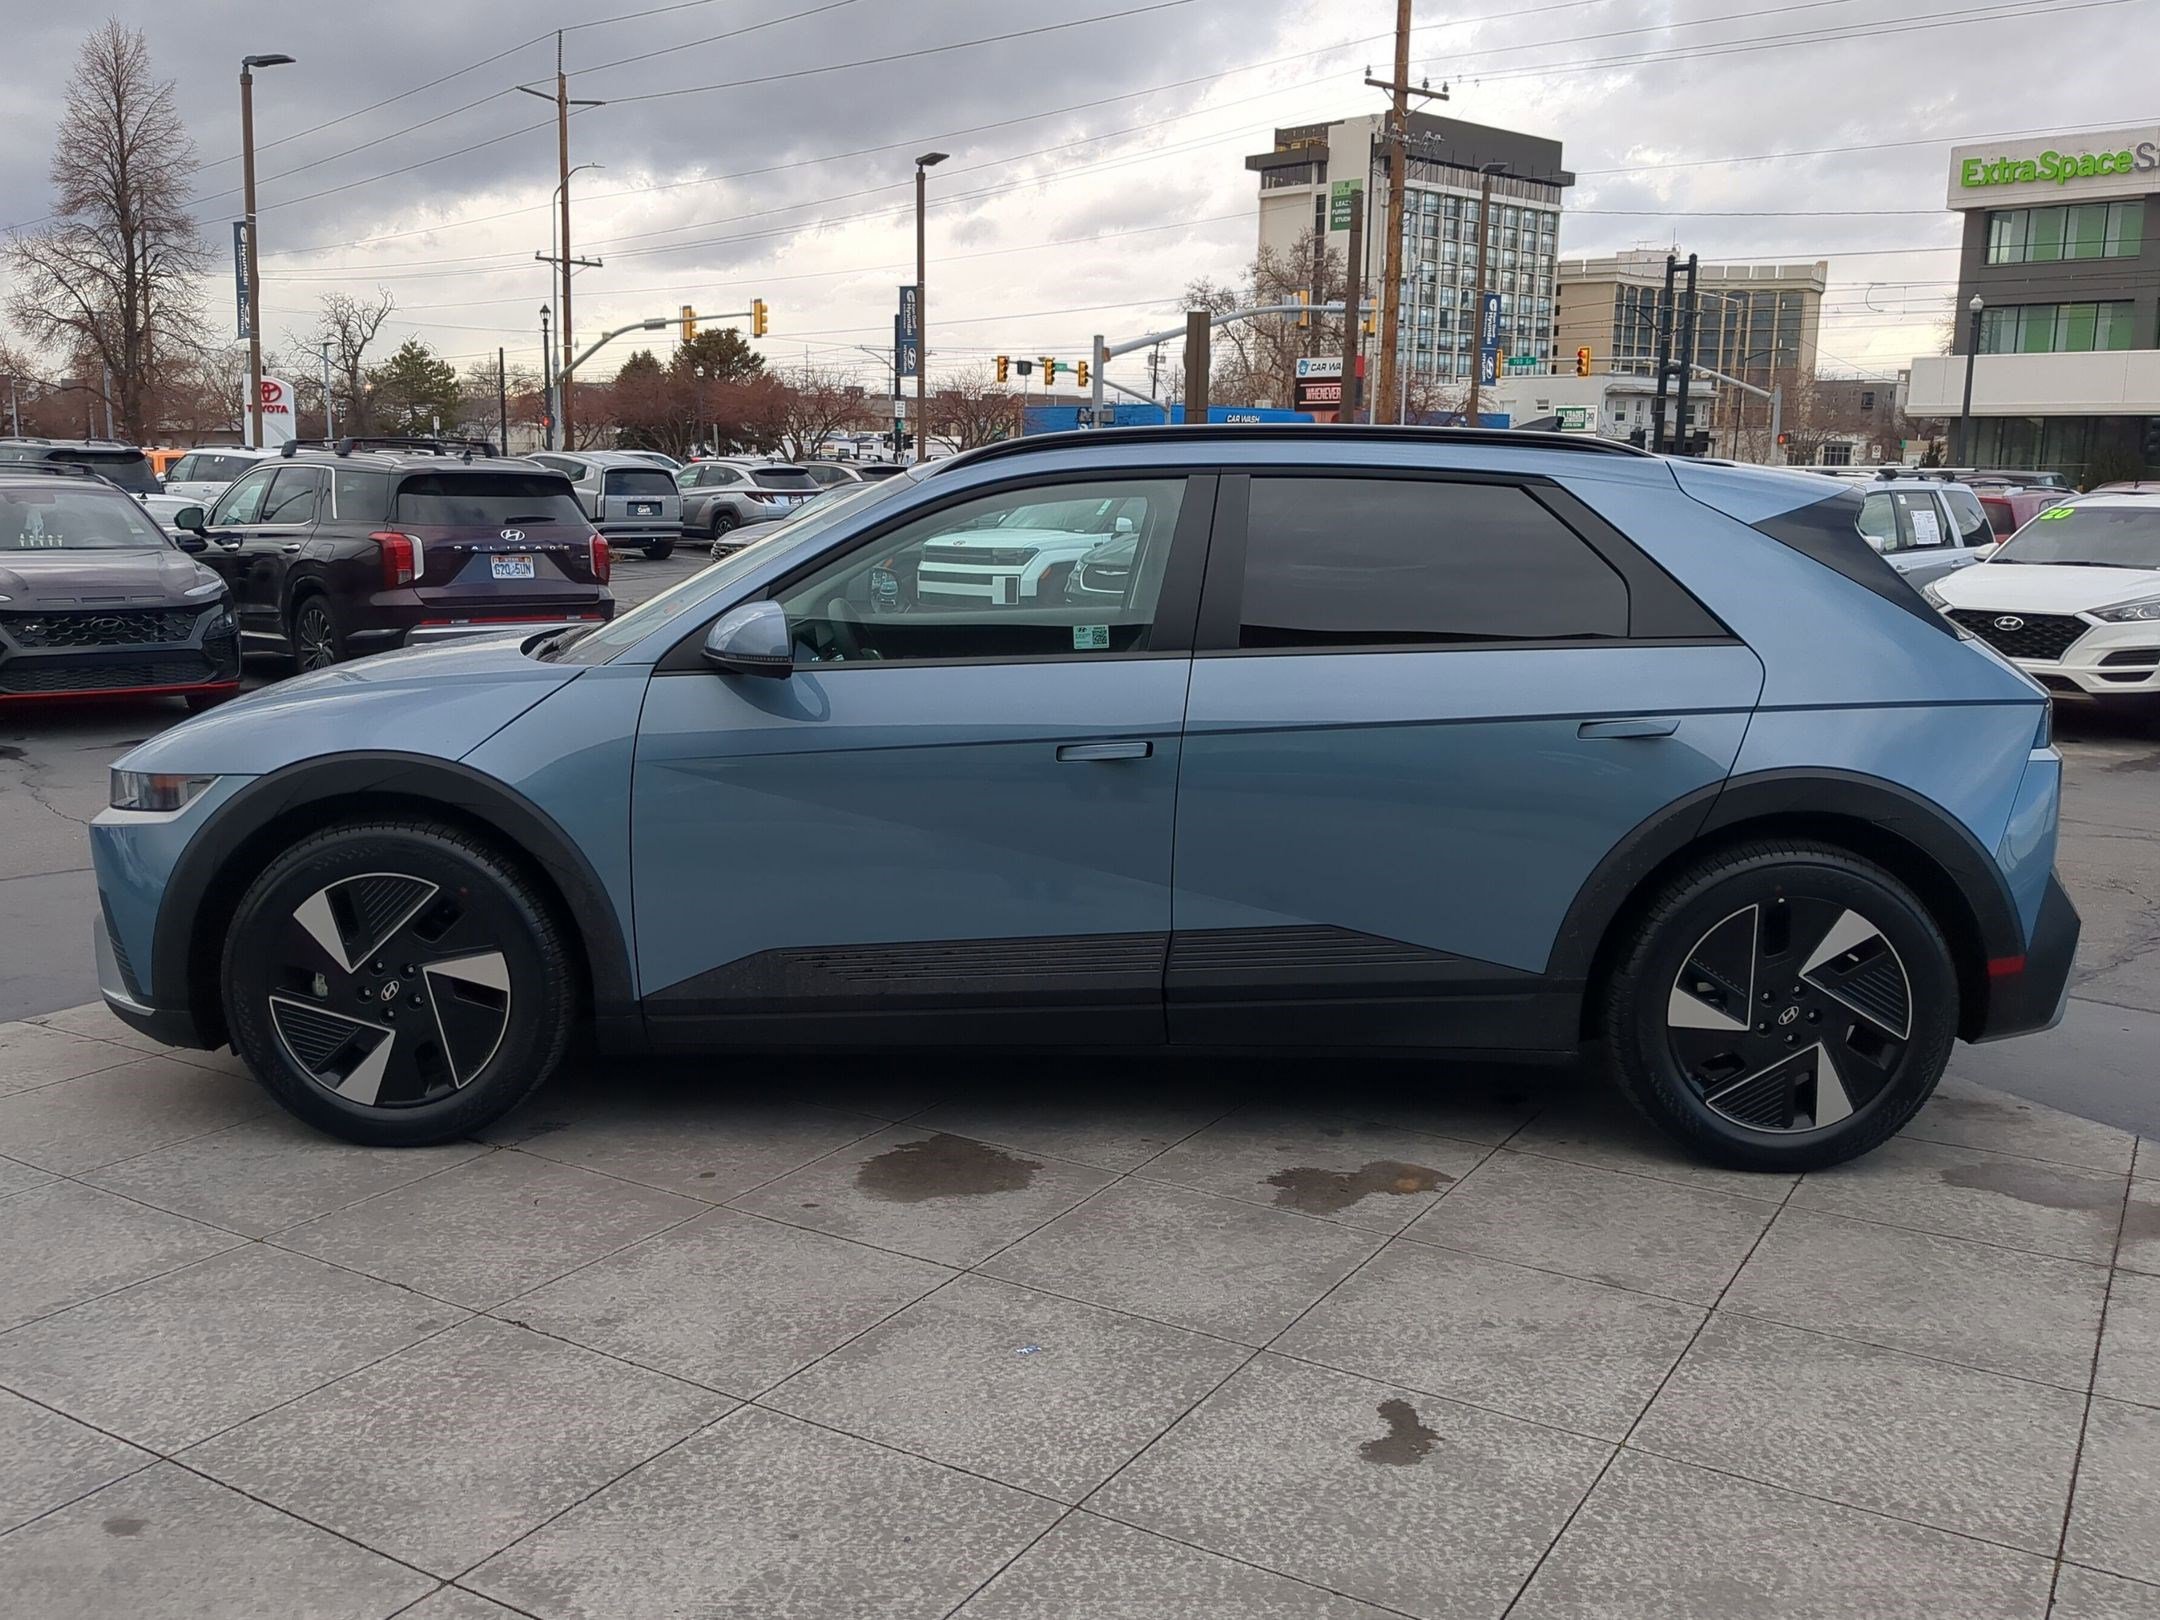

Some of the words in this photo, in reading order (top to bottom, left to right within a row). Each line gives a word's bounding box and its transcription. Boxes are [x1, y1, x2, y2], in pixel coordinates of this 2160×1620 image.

[1310, 363, 1327, 371] CAR
[1328, 362, 1341, 371] WA
[246, 404, 288, 413] TYOTA
[1227, 414, 1240, 423] CAR
[1241, 415, 1260, 423] WASH
[2040, 508, 2074, 519] 20
